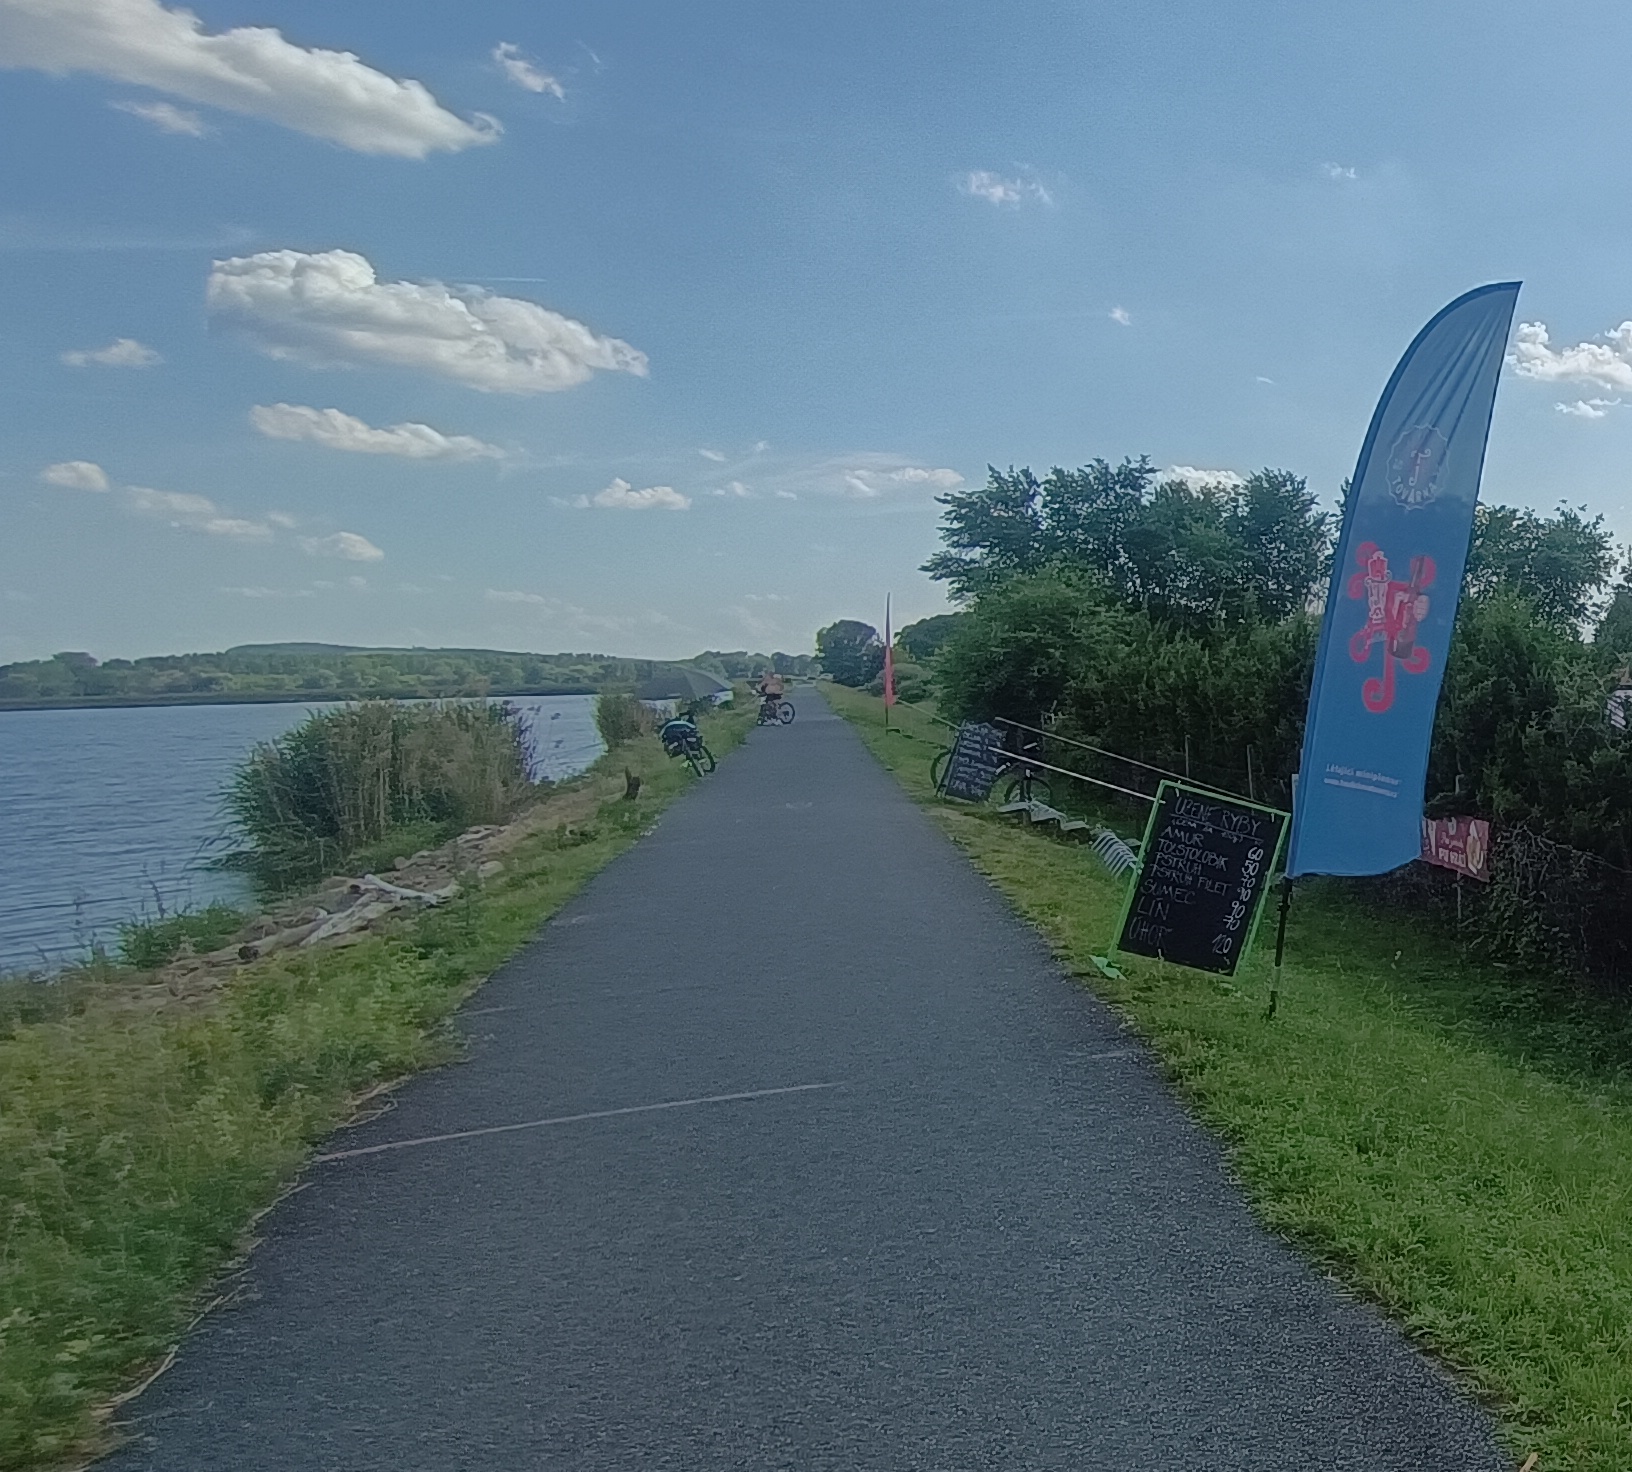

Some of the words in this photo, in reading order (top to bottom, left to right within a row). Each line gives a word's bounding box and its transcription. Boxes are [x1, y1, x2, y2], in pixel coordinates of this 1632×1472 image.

[1221, 809, 1262, 836] RYBY
[1160, 825, 1204, 848] AMUR
[1247, 846, 1264, 861] 60
[1241, 860, 1259, 877] 50
[1140, 878, 1197, 905] SUMEC
[1231, 900, 1245, 918] 90
[1198, 876, 1232, 896] FILET
[1212, 933, 1232, 954] 120
